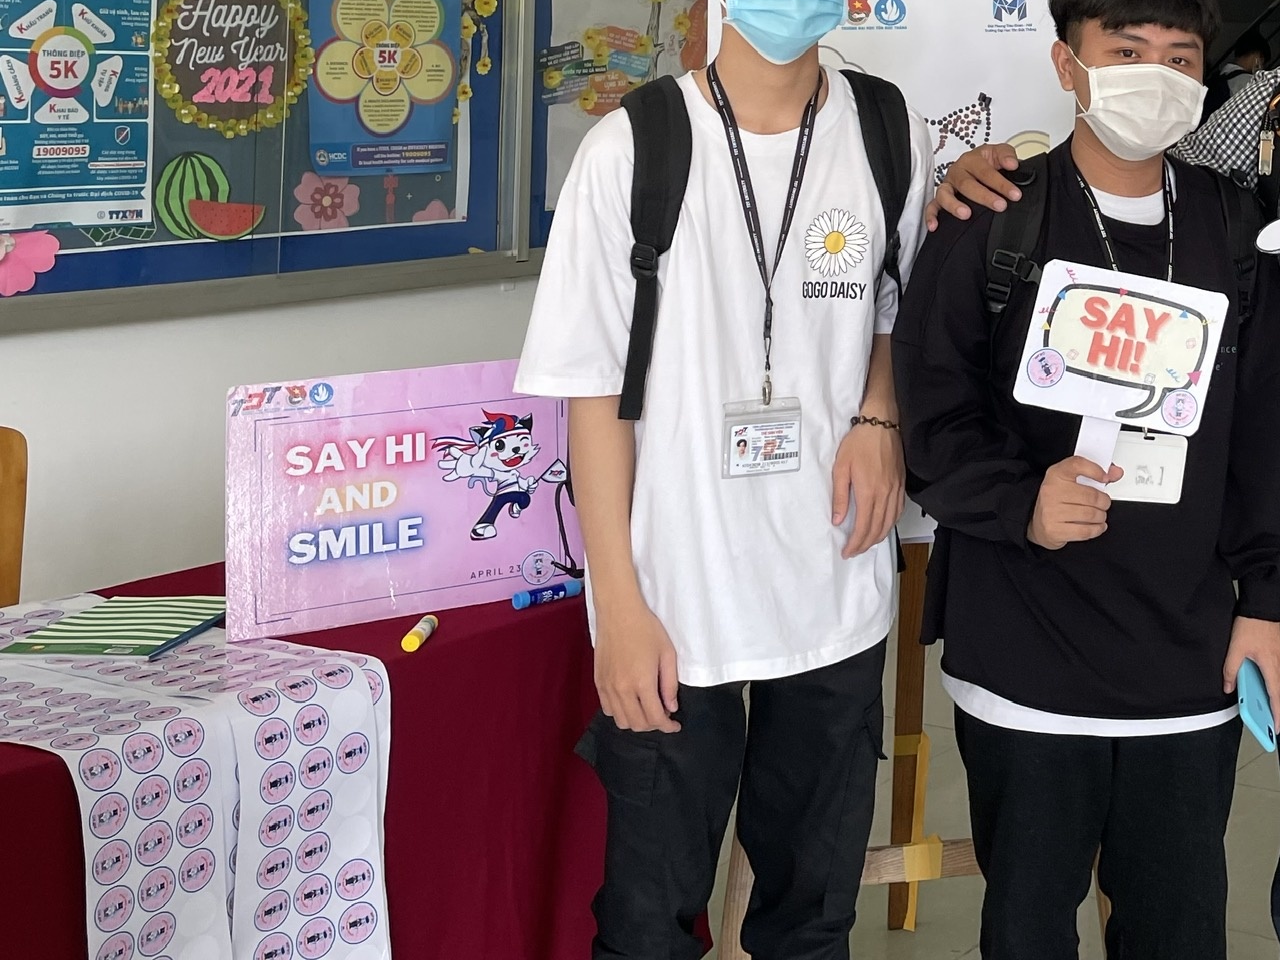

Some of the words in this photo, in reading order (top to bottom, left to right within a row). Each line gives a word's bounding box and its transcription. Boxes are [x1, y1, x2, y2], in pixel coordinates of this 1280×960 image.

[42, 49, 68, 58] THÔNG
[172, 38, 224, 70] New
[230, 36, 288, 71] Year
[378, 50, 398, 64] 5K
[50, 60, 78, 79] 5K
[192, 64, 274, 104] 2021
[36, 146, 87, 156] 19009095
[802, 281, 828, 299] GOGO
[830, 281, 867, 300] DAISY
[1080, 296, 1172, 341] SAY
[1087, 331, 1147, 374] HI!
[1220, 345, 1237, 354] nce
[231, 386, 282, 417] TDT
[734, 426, 748, 437] TDT
[285, 437, 376, 477] SAY
[385, 432, 426, 465] HI
[315, 481, 398, 516] AND
[288, 516, 424, 566] SMILE
[470, 568, 504, 580] APRIL
